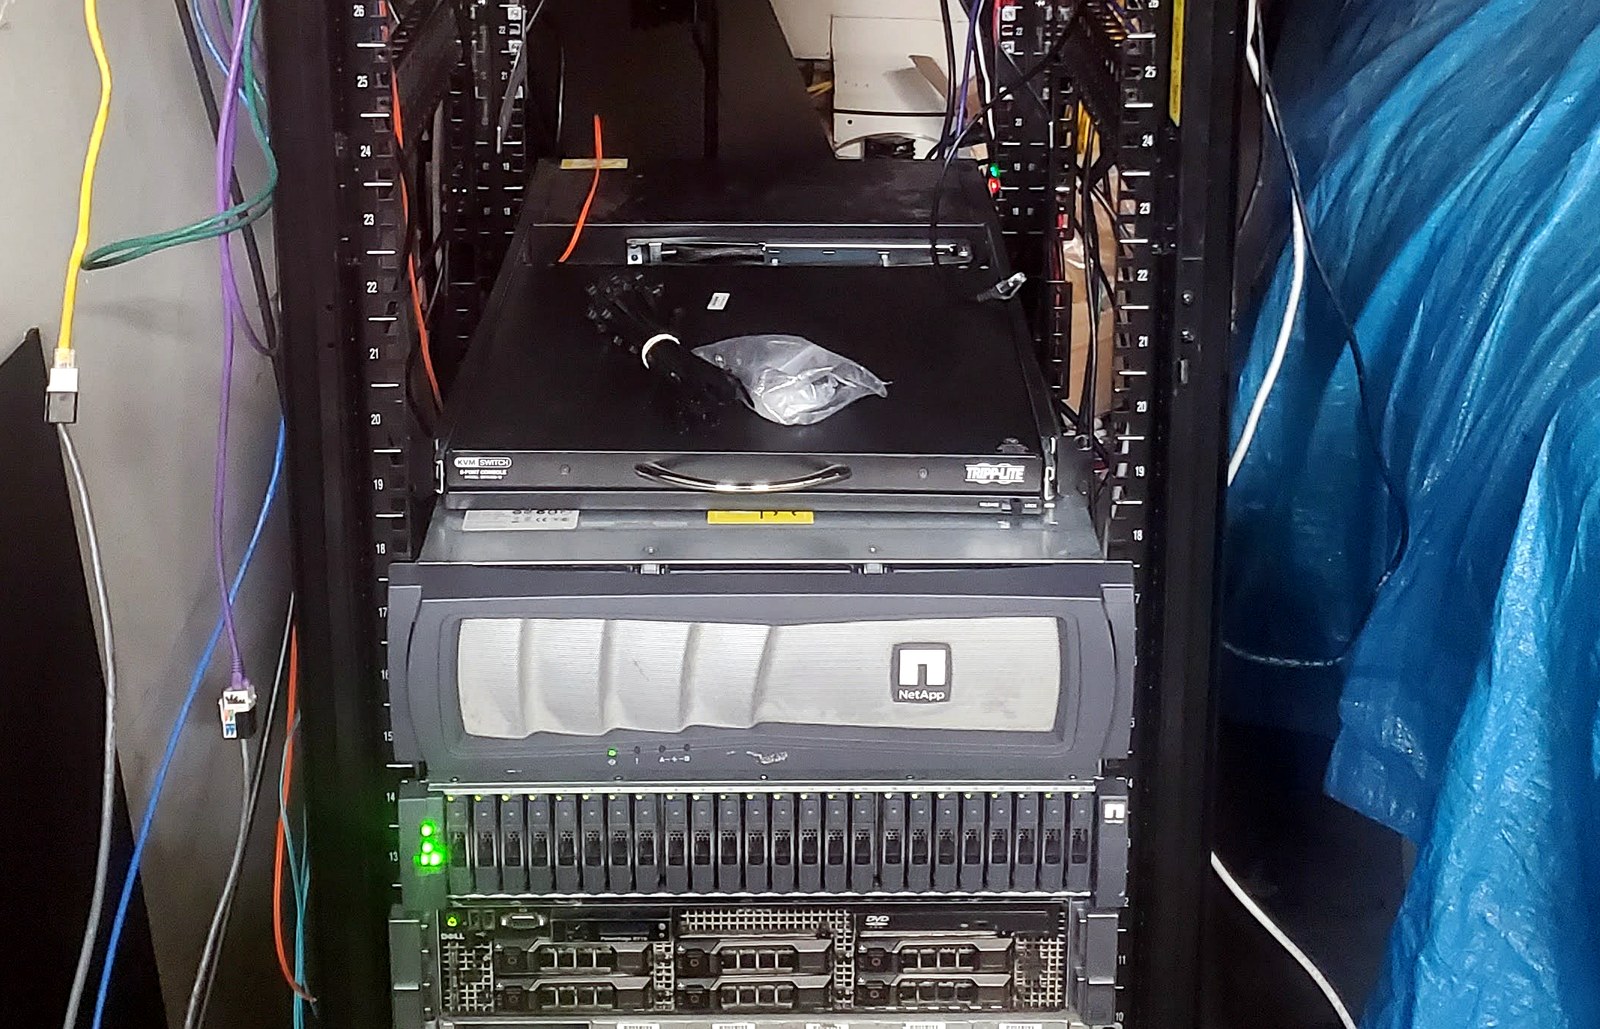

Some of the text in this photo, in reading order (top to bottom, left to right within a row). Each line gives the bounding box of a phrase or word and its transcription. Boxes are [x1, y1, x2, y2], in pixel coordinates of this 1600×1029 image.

[353, 4, 365, 18] 26
[1144, 65, 1157, 78] 25
[356, 75, 369, 88] 25
[1141, 134, 1154, 147] 24
[360, 144, 372, 158] 24
[1139, 201, 1151, 215] 23
[363, 213, 375, 226] 23
[1136, 269, 1149, 282] 22
[366, 281, 378, 294] 22
[1138, 335, 1149, 348] 21
[369, 347, 379, 360] 21
[1136, 400, 1148, 413] 20
[370, 413, 381, 425] 20
[1134, 465, 1145, 477] 19
[373, 478, 384, 491] 19
[1132, 529, 1143, 541] 18
[375, 542, 386, 555] 18
[1134, 593, 1141, 604] 7
[377, 607, 387, 618] 17
[898, 689, 945, 701] NetApp
[386, 791, 396, 803] 14
[389, 850, 399, 862] 13
[1123, 896, 1130, 908] 2
[440, 932, 465, 940] DELL
[1118, 954, 1127, 965] 11
[1115, 1011, 1125, 1022] 10
